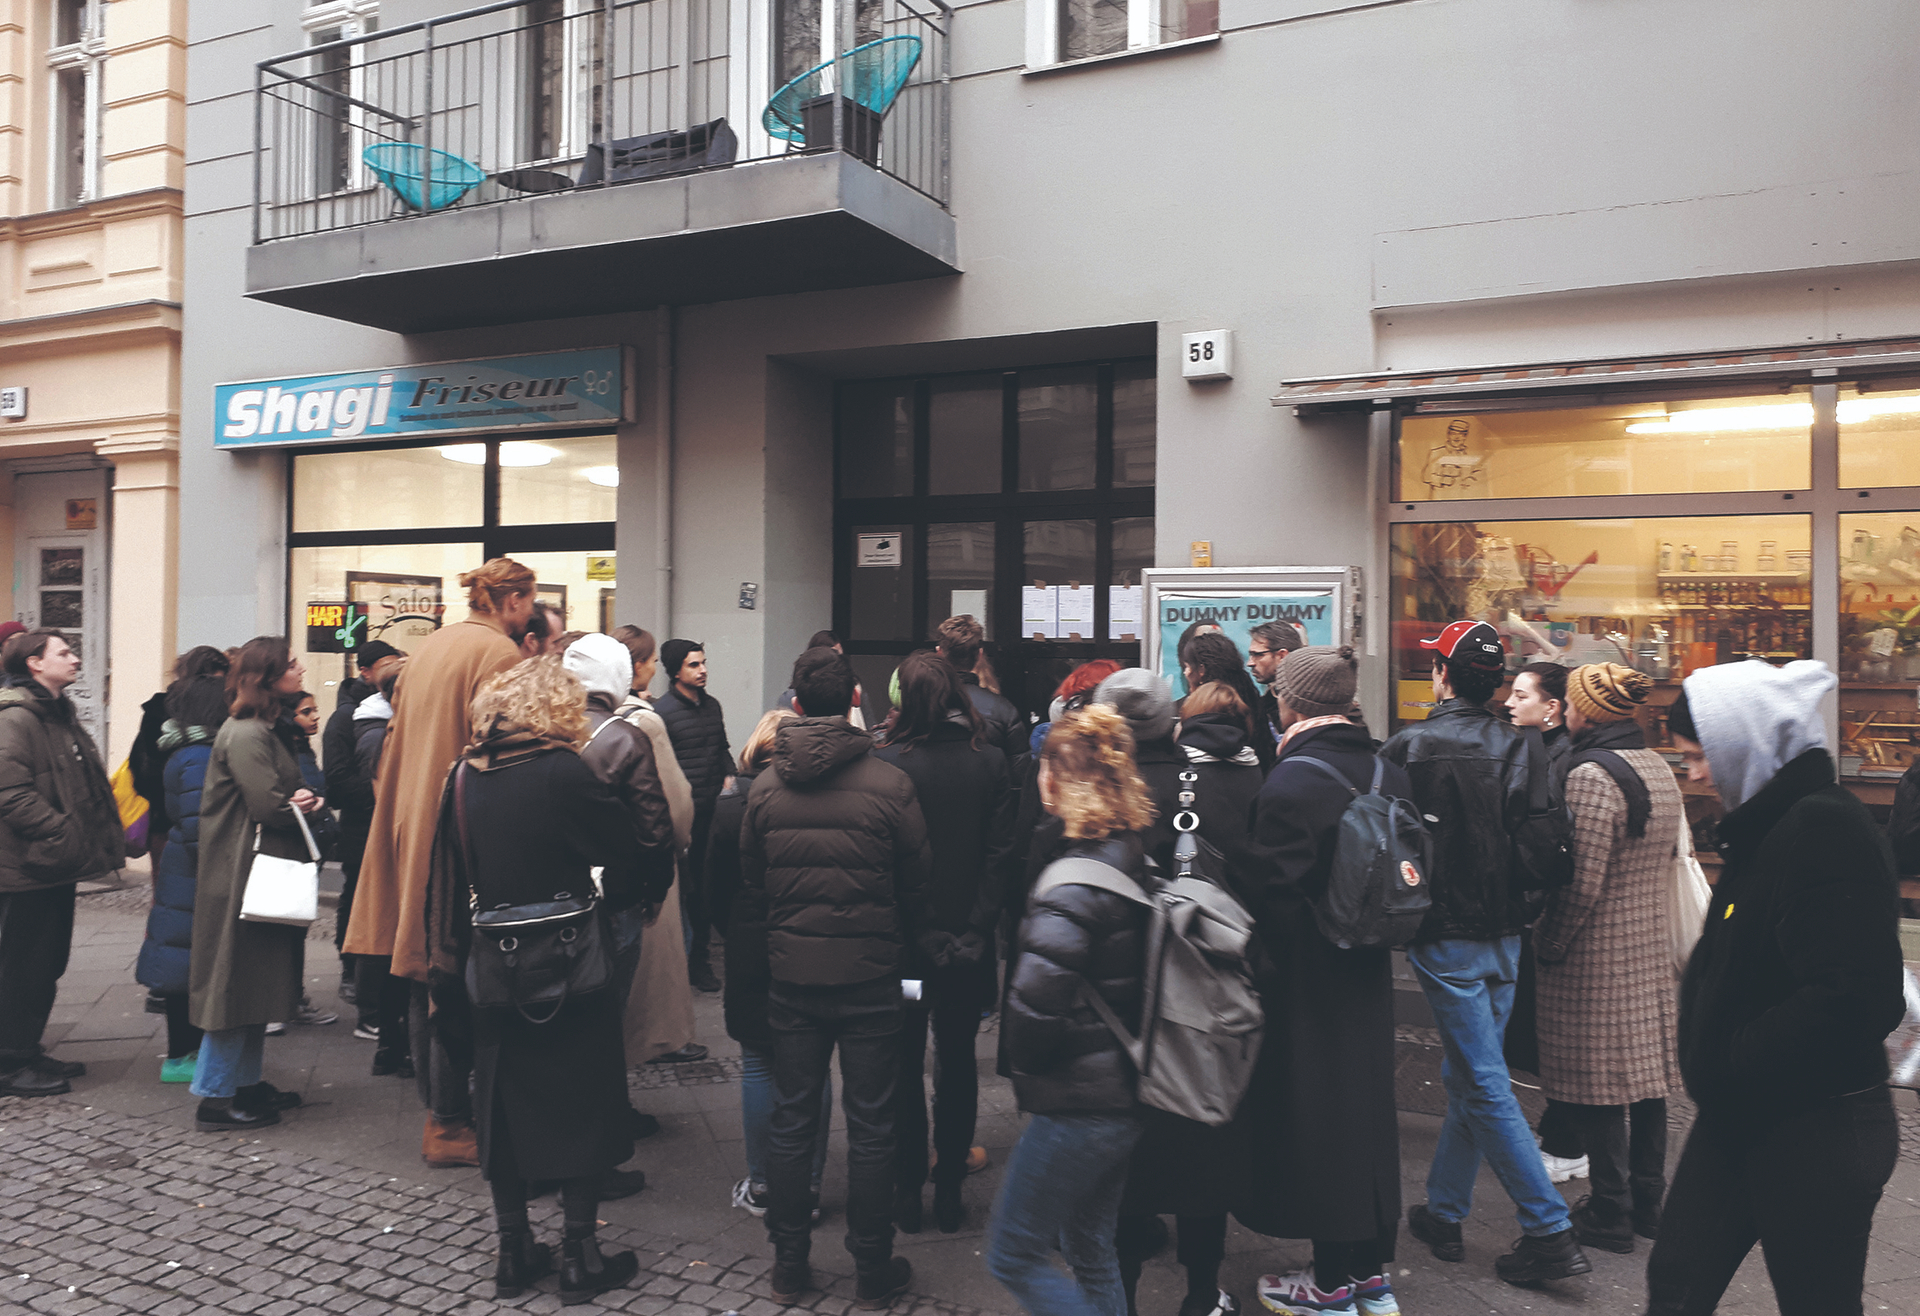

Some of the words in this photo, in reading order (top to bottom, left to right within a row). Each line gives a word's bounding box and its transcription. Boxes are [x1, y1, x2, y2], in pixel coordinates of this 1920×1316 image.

[1189, 341, 1214, 362] 58
[223, 374, 395, 438] Shagi
[407, 375, 579, 408] Friseur
[1166, 606, 1241, 623] DUMMY
[1246, 604, 1327, 621] DUMMY
